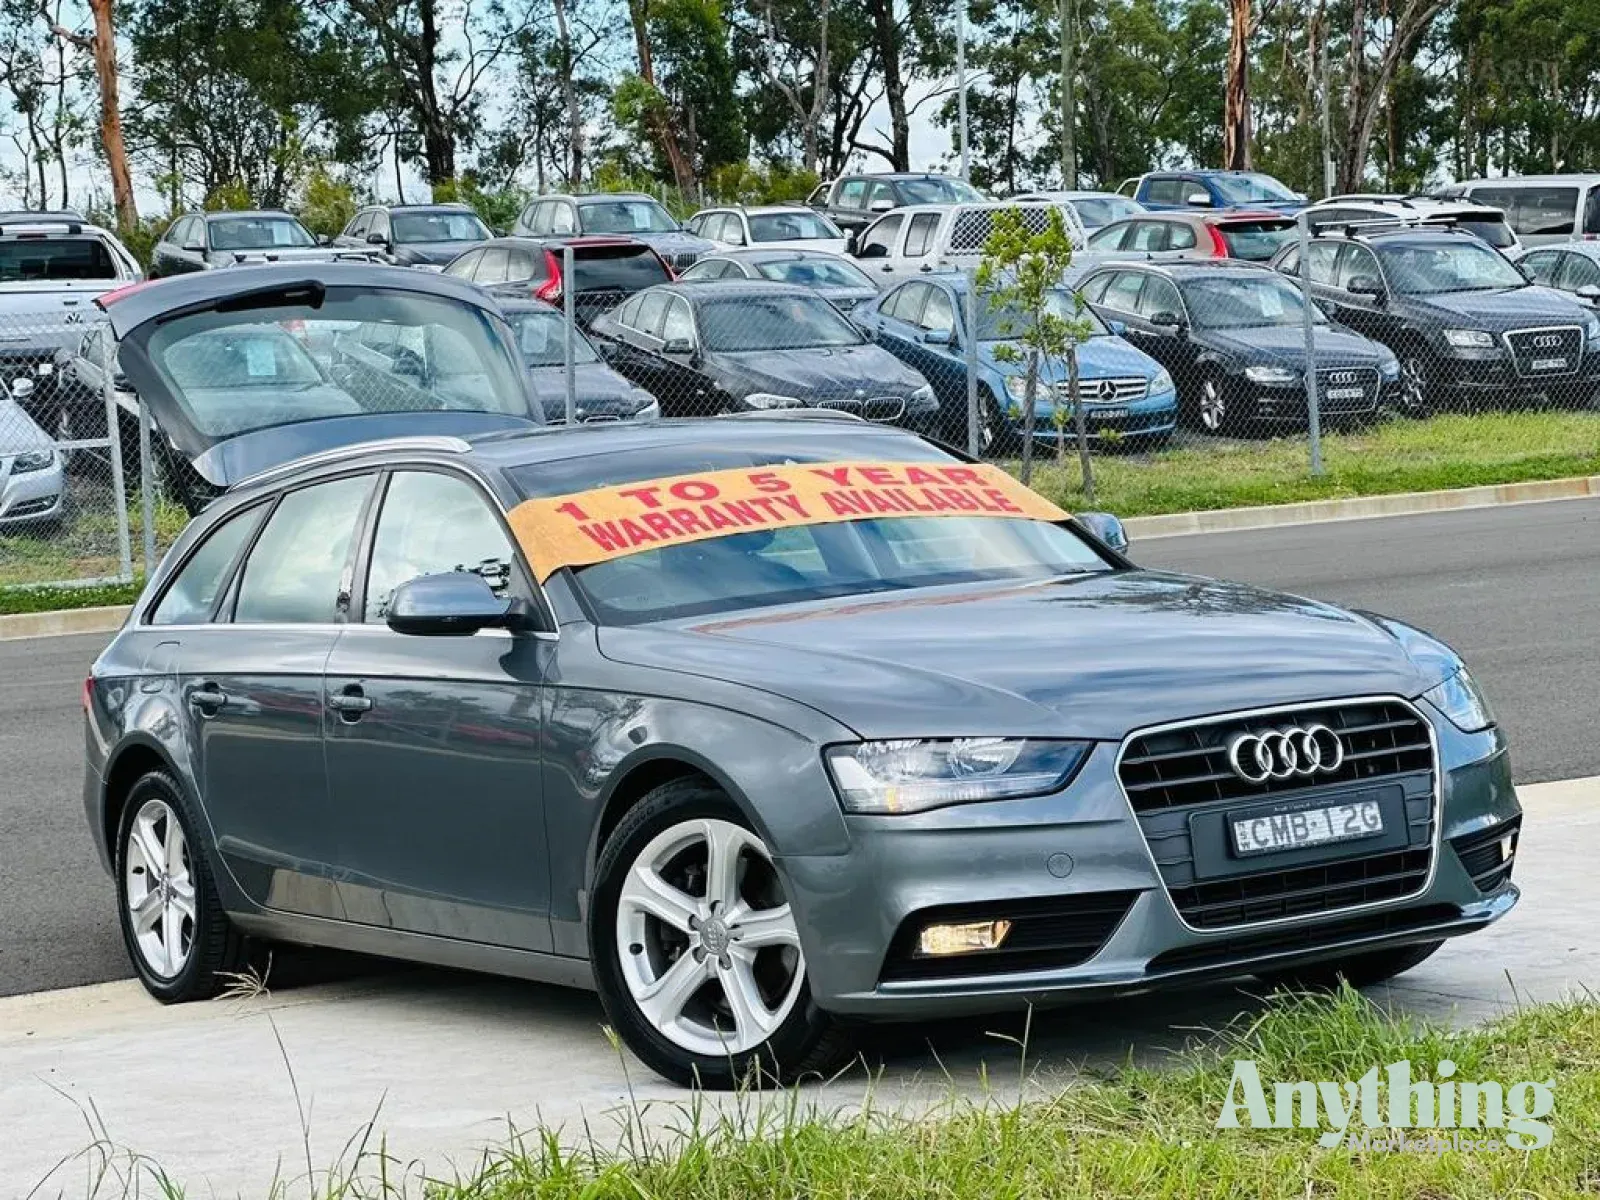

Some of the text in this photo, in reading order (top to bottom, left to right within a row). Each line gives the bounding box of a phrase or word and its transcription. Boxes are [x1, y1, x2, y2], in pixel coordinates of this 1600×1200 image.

[554, 466, 989, 522] 1 TO 5 YEAR
[578, 488, 1024, 550] WARRANTY AVAILABLE
